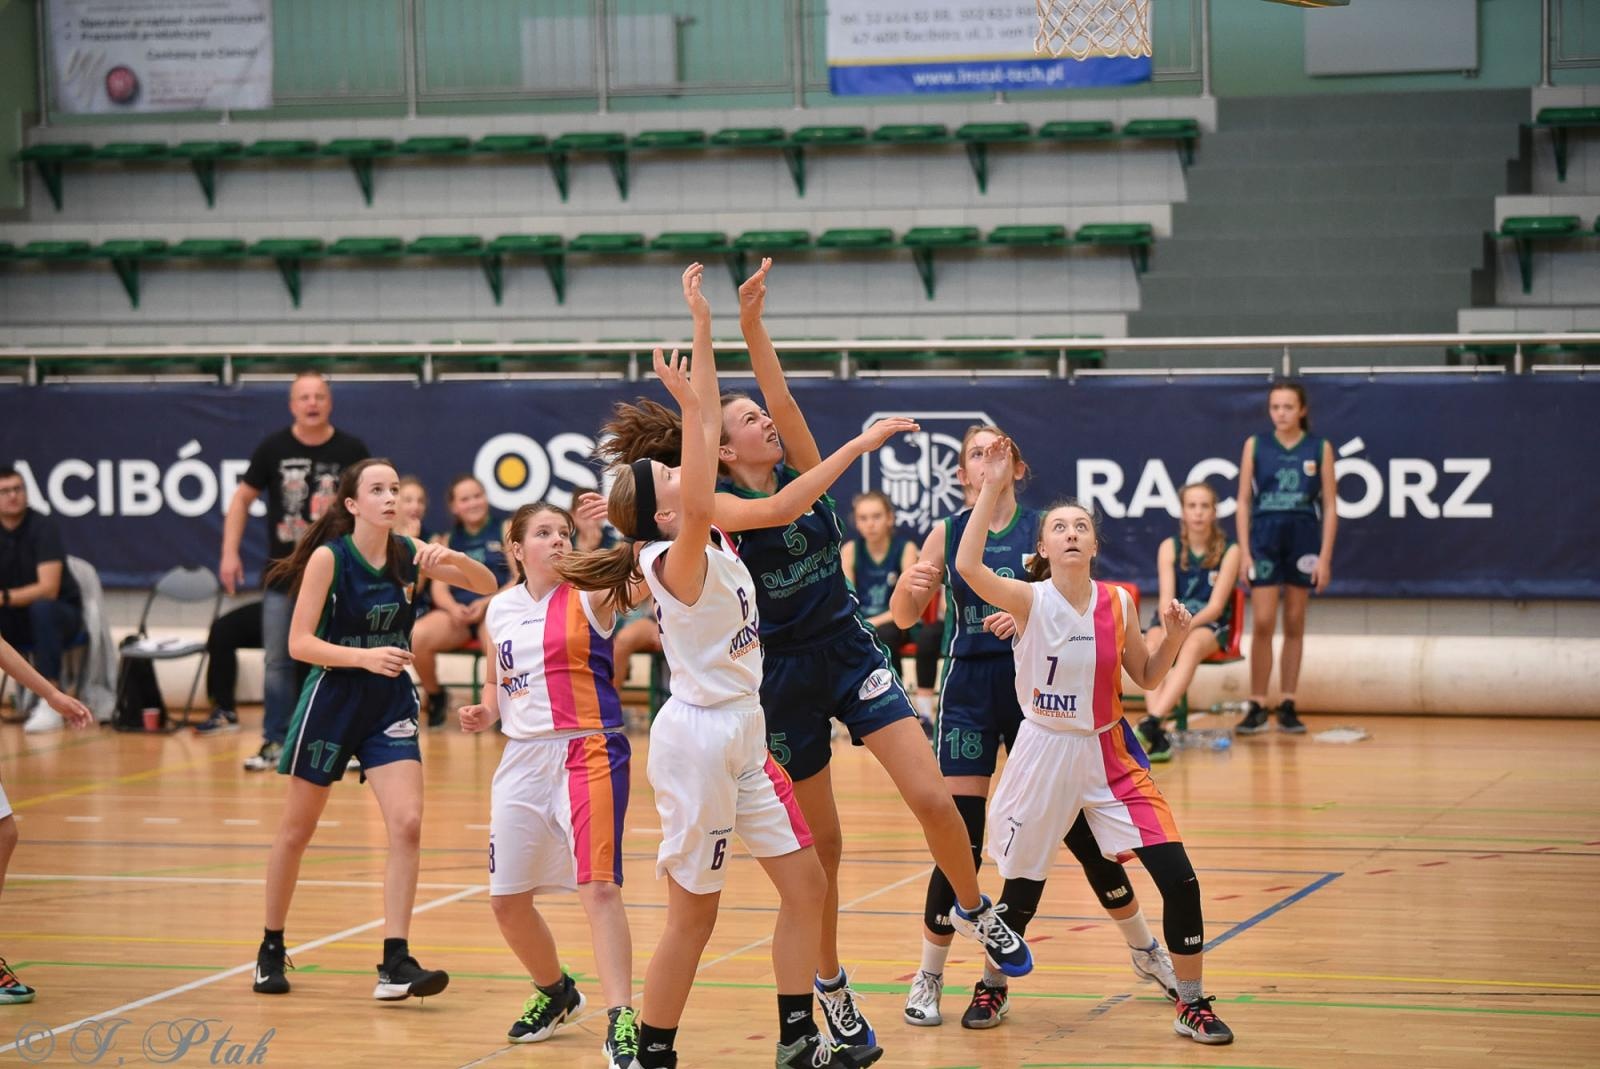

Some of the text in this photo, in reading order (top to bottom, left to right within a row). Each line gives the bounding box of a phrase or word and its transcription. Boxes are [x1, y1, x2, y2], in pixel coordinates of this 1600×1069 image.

[912, 66, 1065, 88] www.instal-tech.pl
[1076, 436, 1493, 519] RACÓRZ
[1274, 468, 1299, 491] 10
[783, 521, 807, 556] 5
[366, 602, 400, 632] 17
[737, 587, 749, 621] 6
[498, 639, 514, 671] 18
[1046, 655, 1059, 686] 7
[1032, 692, 1077, 711] MINI
[307, 739, 343, 774] 17
[770, 732, 792, 766] 5
[946, 728, 983, 760] 18
[711, 837, 727, 870] 6
[1004, 826, 1016, 857] 7
